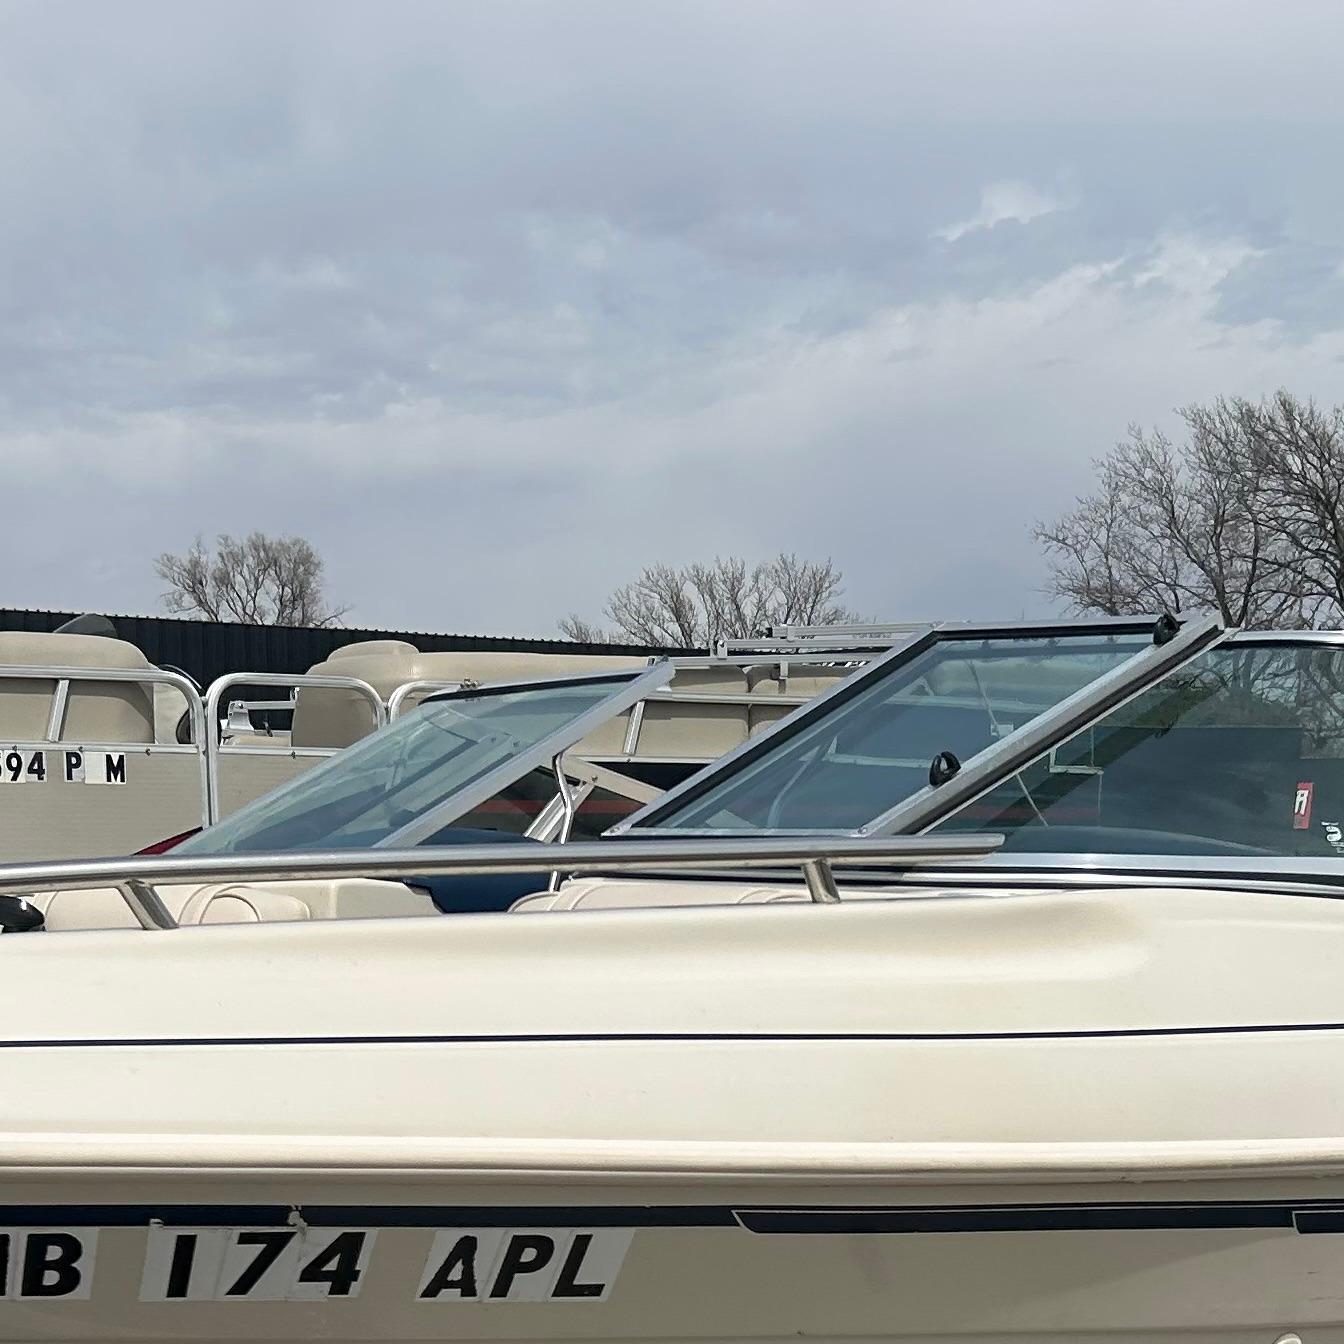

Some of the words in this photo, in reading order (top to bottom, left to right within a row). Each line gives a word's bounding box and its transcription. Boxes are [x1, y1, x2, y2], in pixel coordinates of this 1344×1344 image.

[65, 751, 83, 781] P
[106, 753, 126, 783] M
[166, 1231, 366, 1298] 174
[419, 1234, 606, 1299] APL
